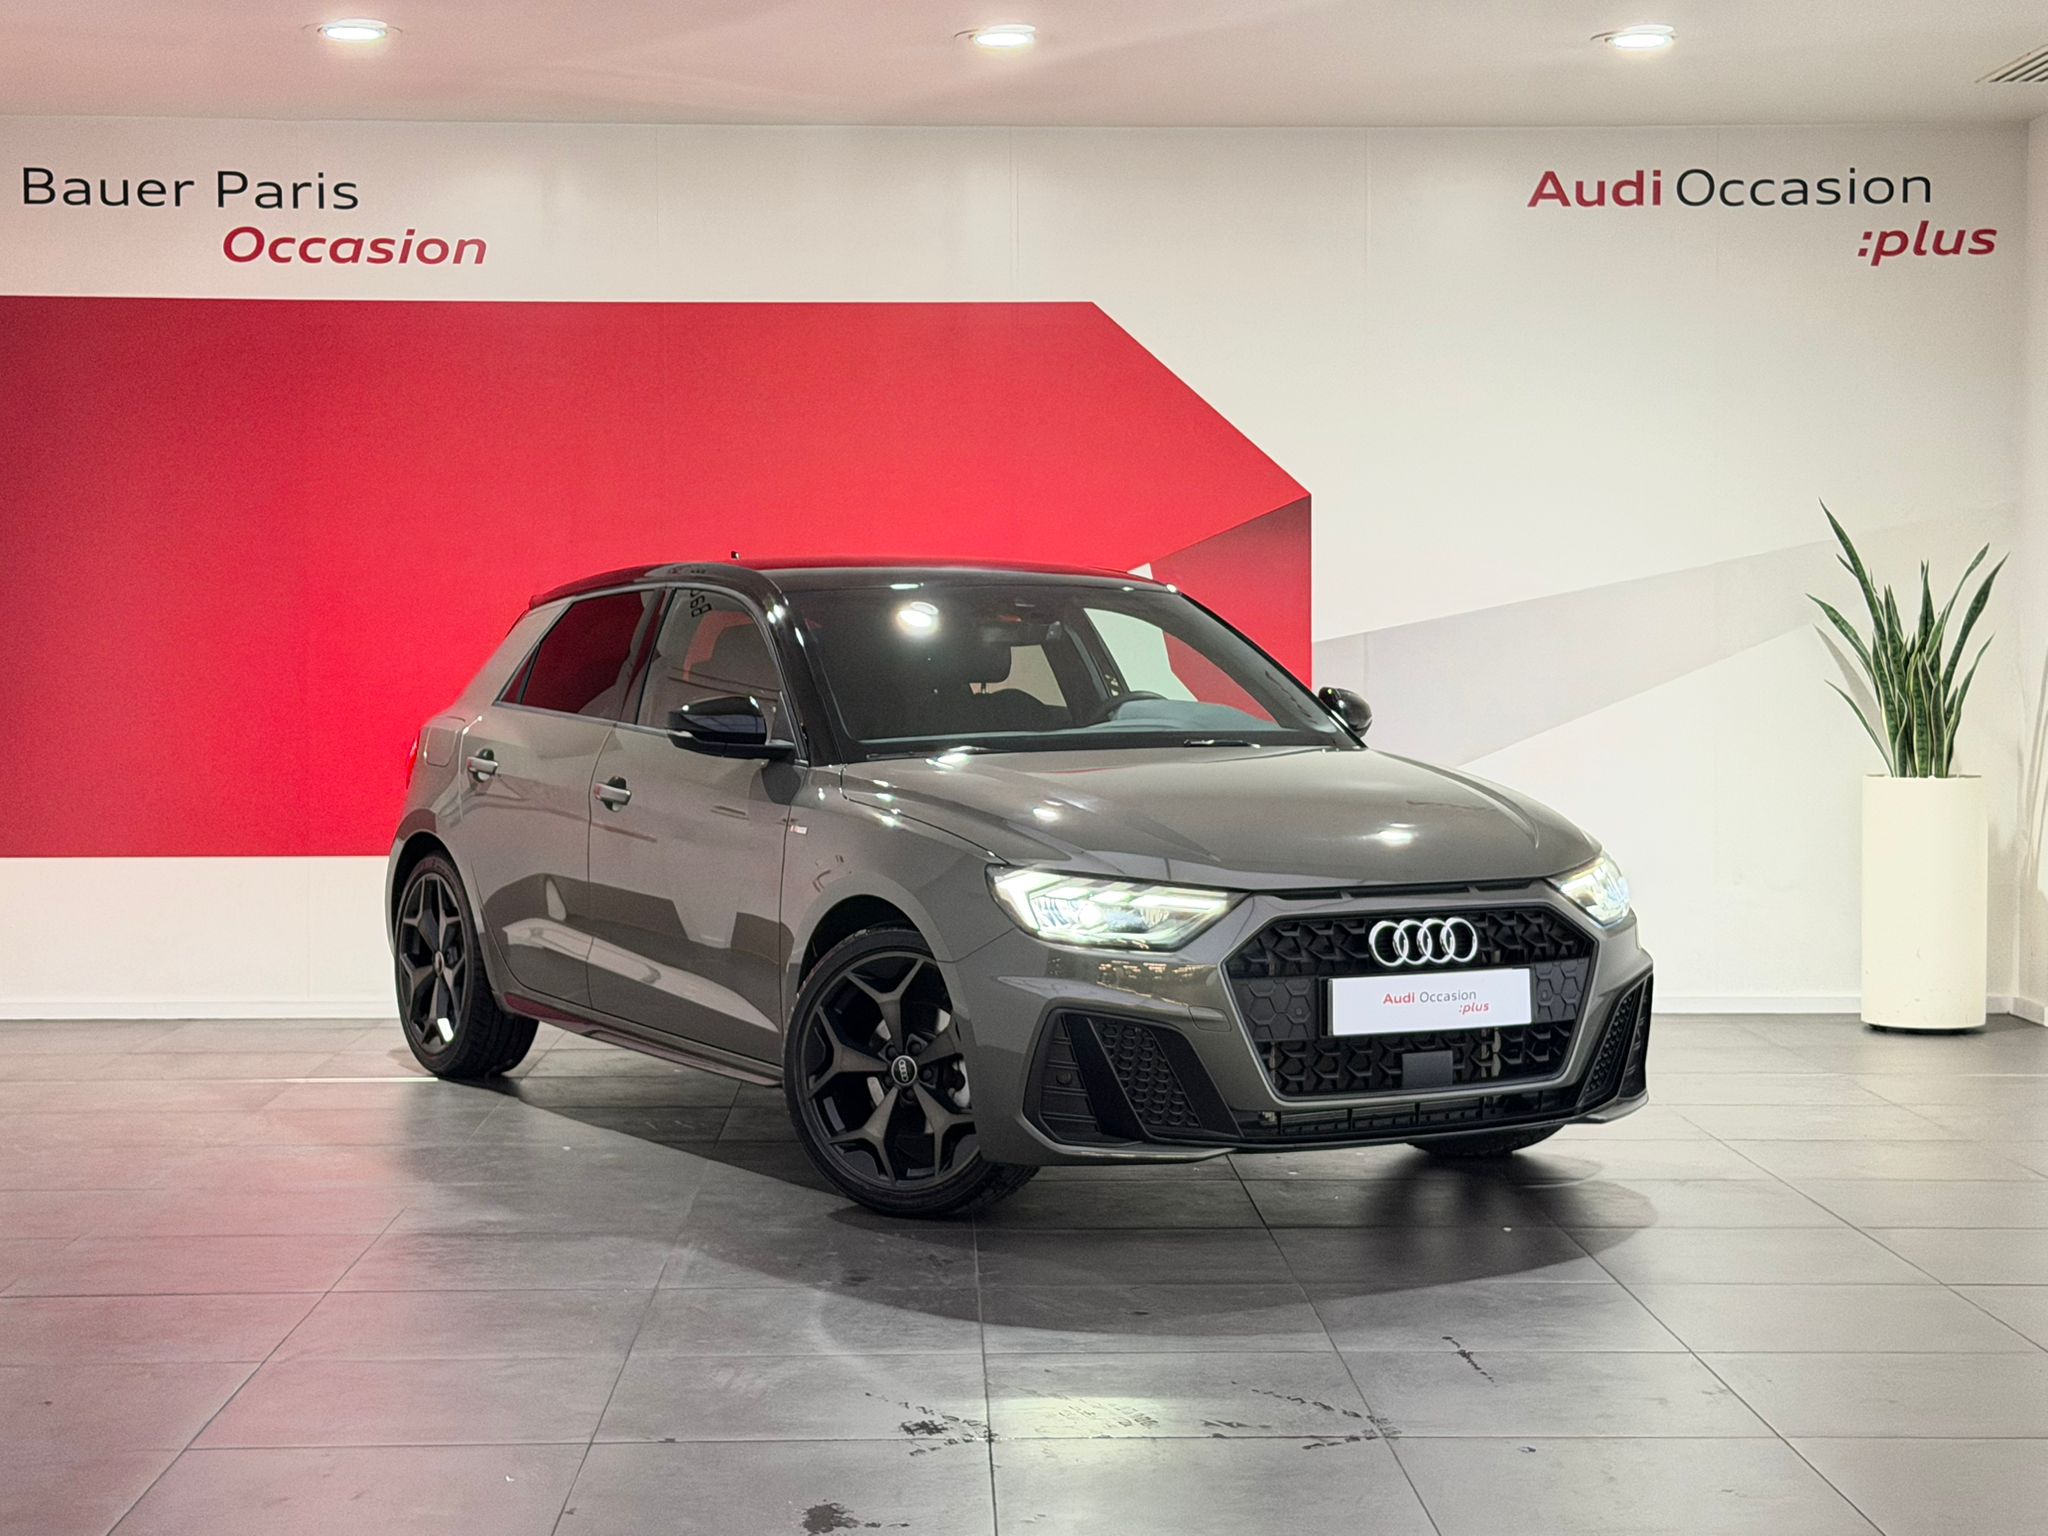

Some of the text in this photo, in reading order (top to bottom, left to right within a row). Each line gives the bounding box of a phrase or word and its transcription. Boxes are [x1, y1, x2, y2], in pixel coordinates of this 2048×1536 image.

[22, 166, 359, 210] Bauer Paris
[1526, 167, 1931, 208] Audi Occasion
[223, 226, 487, 265] Occasion
[1857, 220, 1998, 267] :plus
[1383, 989, 1477, 1005] Audi Occasion
[1459, 1002, 1490, 1015] :plus
